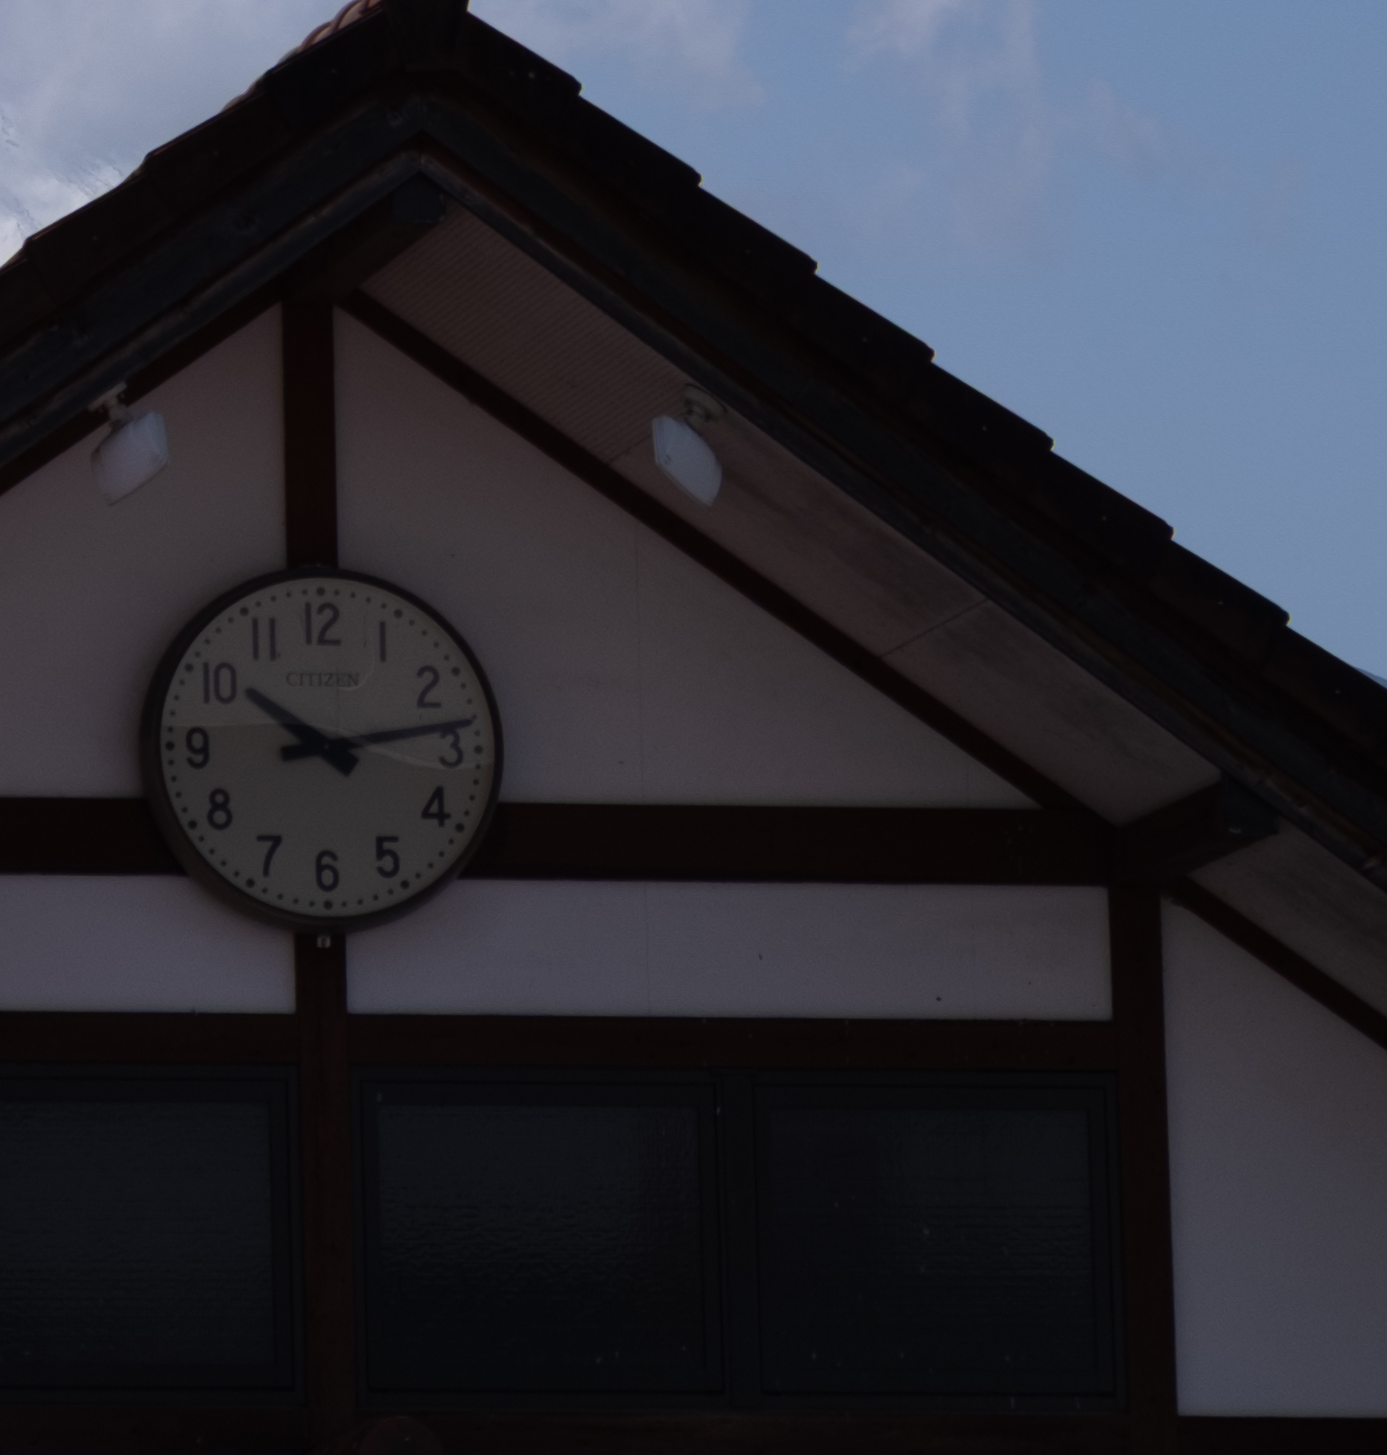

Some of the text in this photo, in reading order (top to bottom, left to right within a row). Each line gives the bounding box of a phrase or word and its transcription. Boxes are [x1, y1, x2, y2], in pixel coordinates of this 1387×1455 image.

[251, 617, 277, 661] 11
[304, 602, 342, 646] 12
[378, 620, 387, 663] 1
[202, 662, 237, 704] 10
[285, 671, 360, 687] CITIZEN
[416, 665, 442, 709] 2
[185, 727, 210, 769] 9
[437, 727, 464, 768] 3
[206, 788, 233, 830] 8
[421, 786, 452, 828] 4
[256, 835, 283, 878] 7
[315, 849, 340, 892] 6
[375, 836, 400, 878] 5
